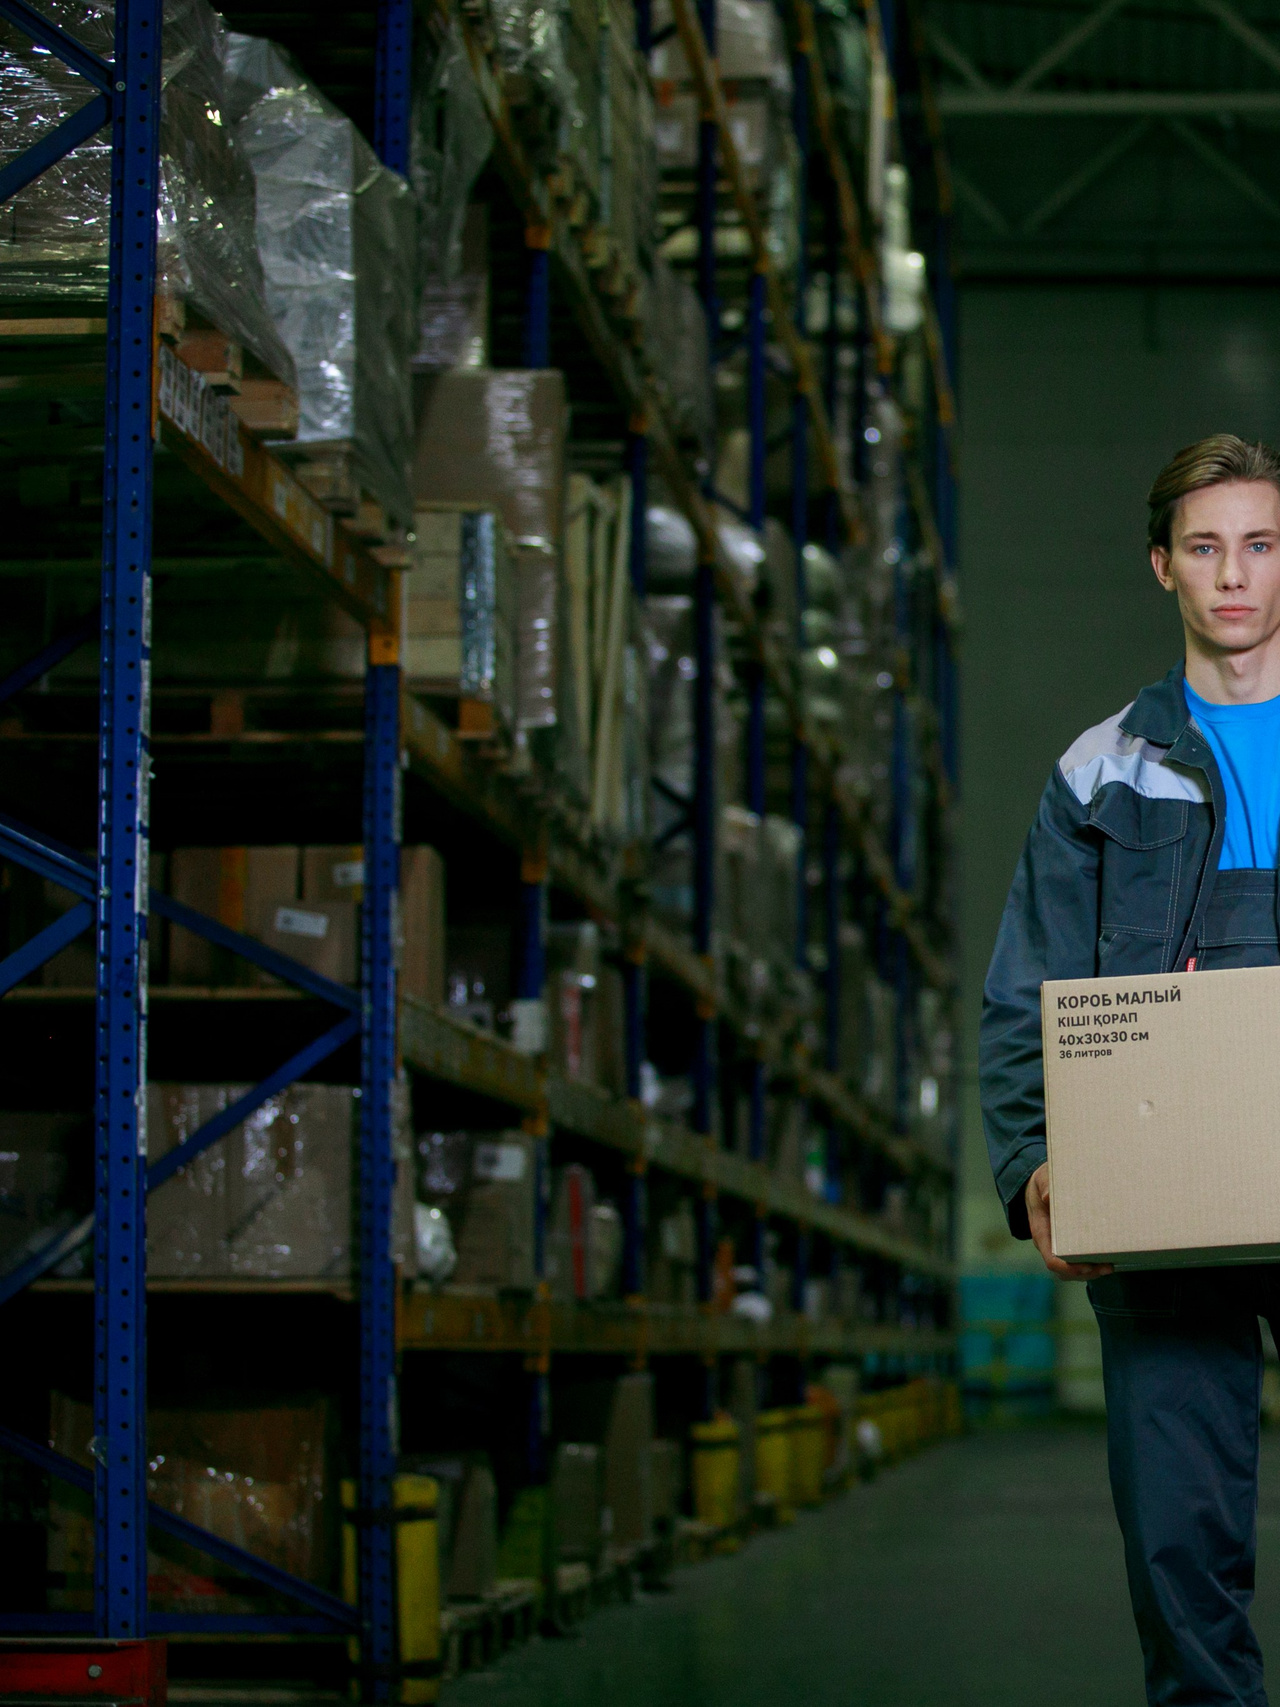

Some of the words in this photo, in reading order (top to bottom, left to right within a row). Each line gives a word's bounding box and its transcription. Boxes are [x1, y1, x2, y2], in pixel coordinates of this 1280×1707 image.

[1057, 994, 1112, 1010] КОРОБ
[1116, 985, 1181, 1006] МАЛЫЙ
[1058, 1015, 1090, 1028] КІШІ
[1094, 1012, 1138, 1027] ҚОРАП
[1131, 1032, 1149, 1041] см
[1059, 1050, 1072, 1059] 36
[1074, 1048, 1112, 1058] литров
